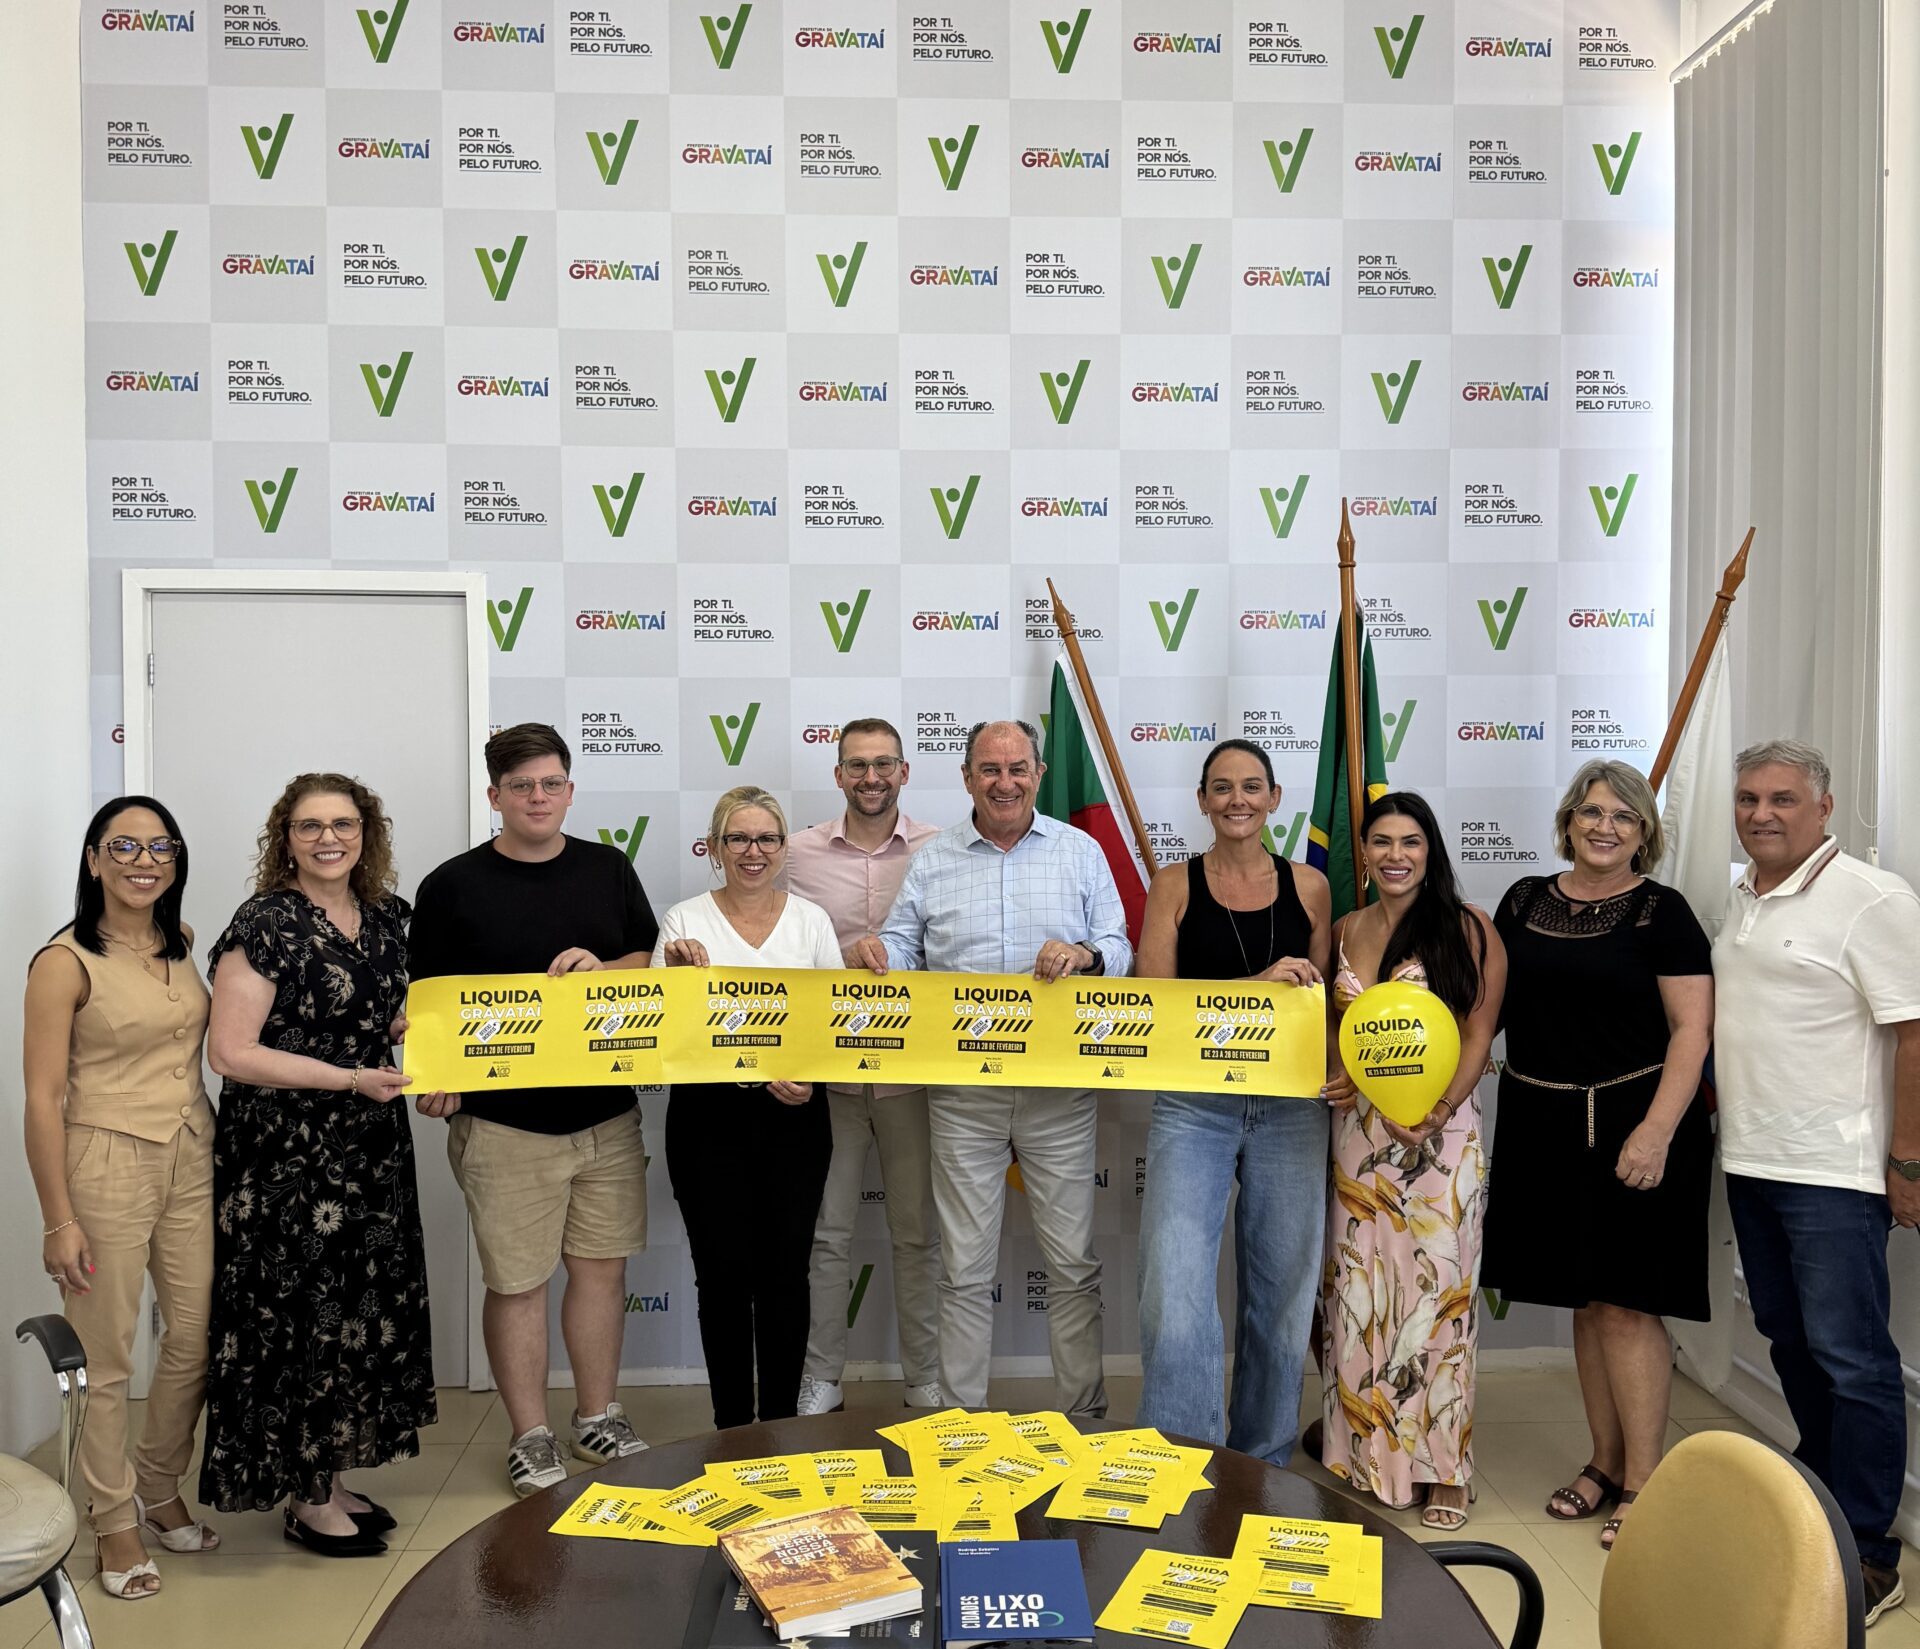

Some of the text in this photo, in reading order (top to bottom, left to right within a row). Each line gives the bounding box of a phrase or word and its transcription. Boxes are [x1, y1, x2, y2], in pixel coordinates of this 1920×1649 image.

[224, 5, 265, 15] POR TI.
[102, 10, 194, 32] GRAVATAÍ
[224, 18, 280, 31] POR NÓS.
[913, 17, 952, 27] POR TI.
[454, 22, 545, 43] GRAVATAÍ
[795, 28, 885, 48] GRAVATAÍ
[913, 30, 966, 43] POR NÓS.
[224, 37, 308, 48] PELO FUTURO.
[1133, 33, 1221, 53] GRAVATAÍ
[1466, 37, 1552, 57] GRAVATAÍ
[913, 49, 993, 60] PELO FUTURO.
[459, 128, 499, 138] POR TI.
[338, 138, 430, 159] GRAVATAÍ
[459, 141, 514, 154] POR NÓS.
[1138, 137, 1176, 147] POR TI.
[682, 144, 772, 165] GRAVATAÍ
[1021, 148, 1110, 168] GRAVATAÍ
[1138, 150, 1190, 162] POR NÓS.
[1355, 152, 1441, 172] GRAVATAÍ
[459, 160, 541, 171] PELO FUTURO.
[1138, 168, 1216, 179] PELO FUTURO.
[223, 254, 314, 275] GRAVATAÍ
[569, 260, 659, 281] GRAVATAÍ
[910, 265, 998, 286] GRAVATAÍ
[1243, 267, 1330, 286] GRAVATAÍ
[1573, 268, 1658, 287] GRAVATAÍ
[106, 371, 199, 391] GRAVATAÍ
[1576, 370, 1614, 380] POR TI.
[458, 376, 549, 397] GRAVATAÍ
[799, 382, 887, 401] GRAVATAÍ
[1132, 382, 1219, 402] GRAVATAÍ
[1462, 382, 1549, 401] GRAVATAÍ
[1576, 383, 1627, 395] POR NÓS.
[1576, 400, 1653, 411] PELO FUTURO.
[112, 477, 153, 487] POR TI.
[1465, 484, 1503, 494] POR TI.
[112, 490, 168, 502] POR NÓS.
[805, 486, 844, 495] POR TI.
[343, 492, 435, 512] GRAVATAÍ
[688, 496, 777, 516] GRAVATAÍ
[805, 498, 858, 510] POR NÓS.
[1021, 497, 1108, 516] GRAVATAÍ
[1351, 497, 1437, 516] GRAVATAÍ
[1465, 497, 1517, 509] POR NÓS.
[112, 508, 196, 519] PELO FUTURO.
[805, 516, 884, 526] PELO FUTURO.
[1465, 514, 1543, 525] PELO FUTURO.
[694, 599, 733, 609] POR TI.
[576, 610, 666, 630] GRAVATAÍ
[694, 612, 747, 624] POR NÓS.
[912, 611, 999, 630] GRAVATAÍ
[1240, 610, 1326, 630] GRAVATAÍ
[1569, 609, 1654, 628] GRAVATAÍ
[694, 629, 774, 640] PELO FUTURO.
[1131, 723, 1215, 742] GRAVATAÍ
[1458, 721, 1544, 741] GRAVATAÍ
[586, 984, 664, 1002] LIQUIDA
[708, 982, 788, 997] LIQUIDA
[832, 984, 910, 999] LIQUIDA
[954, 988, 1032, 1003] LIQUIDA
[461, 990, 542, 1006] LIQUIDA
[707, 996, 787, 1010] GRAVATAÍ
[831, 998, 910, 1013] GRAVATAÍ
[1076, 992, 1153, 1007] LIQUIDA
[1196, 996, 1274, 1011] LIQUIDA
[460, 1003, 541, 1020] GRAVATAÍ
[585, 999, 663, 1015] GRAVATAÍ
[954, 1003, 1032, 1017] GRAVATAÍ
[1076, 1007, 1153, 1021] GRAVATAÍ
[1196, 1010, 1274, 1024] GRAVATAÍ
[1354, 1019, 1424, 1035] LIQUIDA
[1129, 1448, 1181, 1460] LIQUIDA
[733, 1462, 788, 1472] LIQUIDA
[1000, 1456, 1044, 1472] LIQUIDA
[1103, 1462, 1156, 1473] LIQUIDA
[660, 1488, 706, 1508] LIQUIDA
[577, 1498, 606, 1523] LIQUIDA
[766, 1525, 823, 1544] NOSSA
[1270, 1526, 1330, 1538] LIQUIDA
[775, 1540, 834, 1559] NOSSA
[781, 1548, 839, 1566] GENTE
[1168, 1562, 1230, 1576] LIQUIDA
[984, 1594, 1044, 1610] LIXO
[960, 1596, 980, 1628] CIDADES
